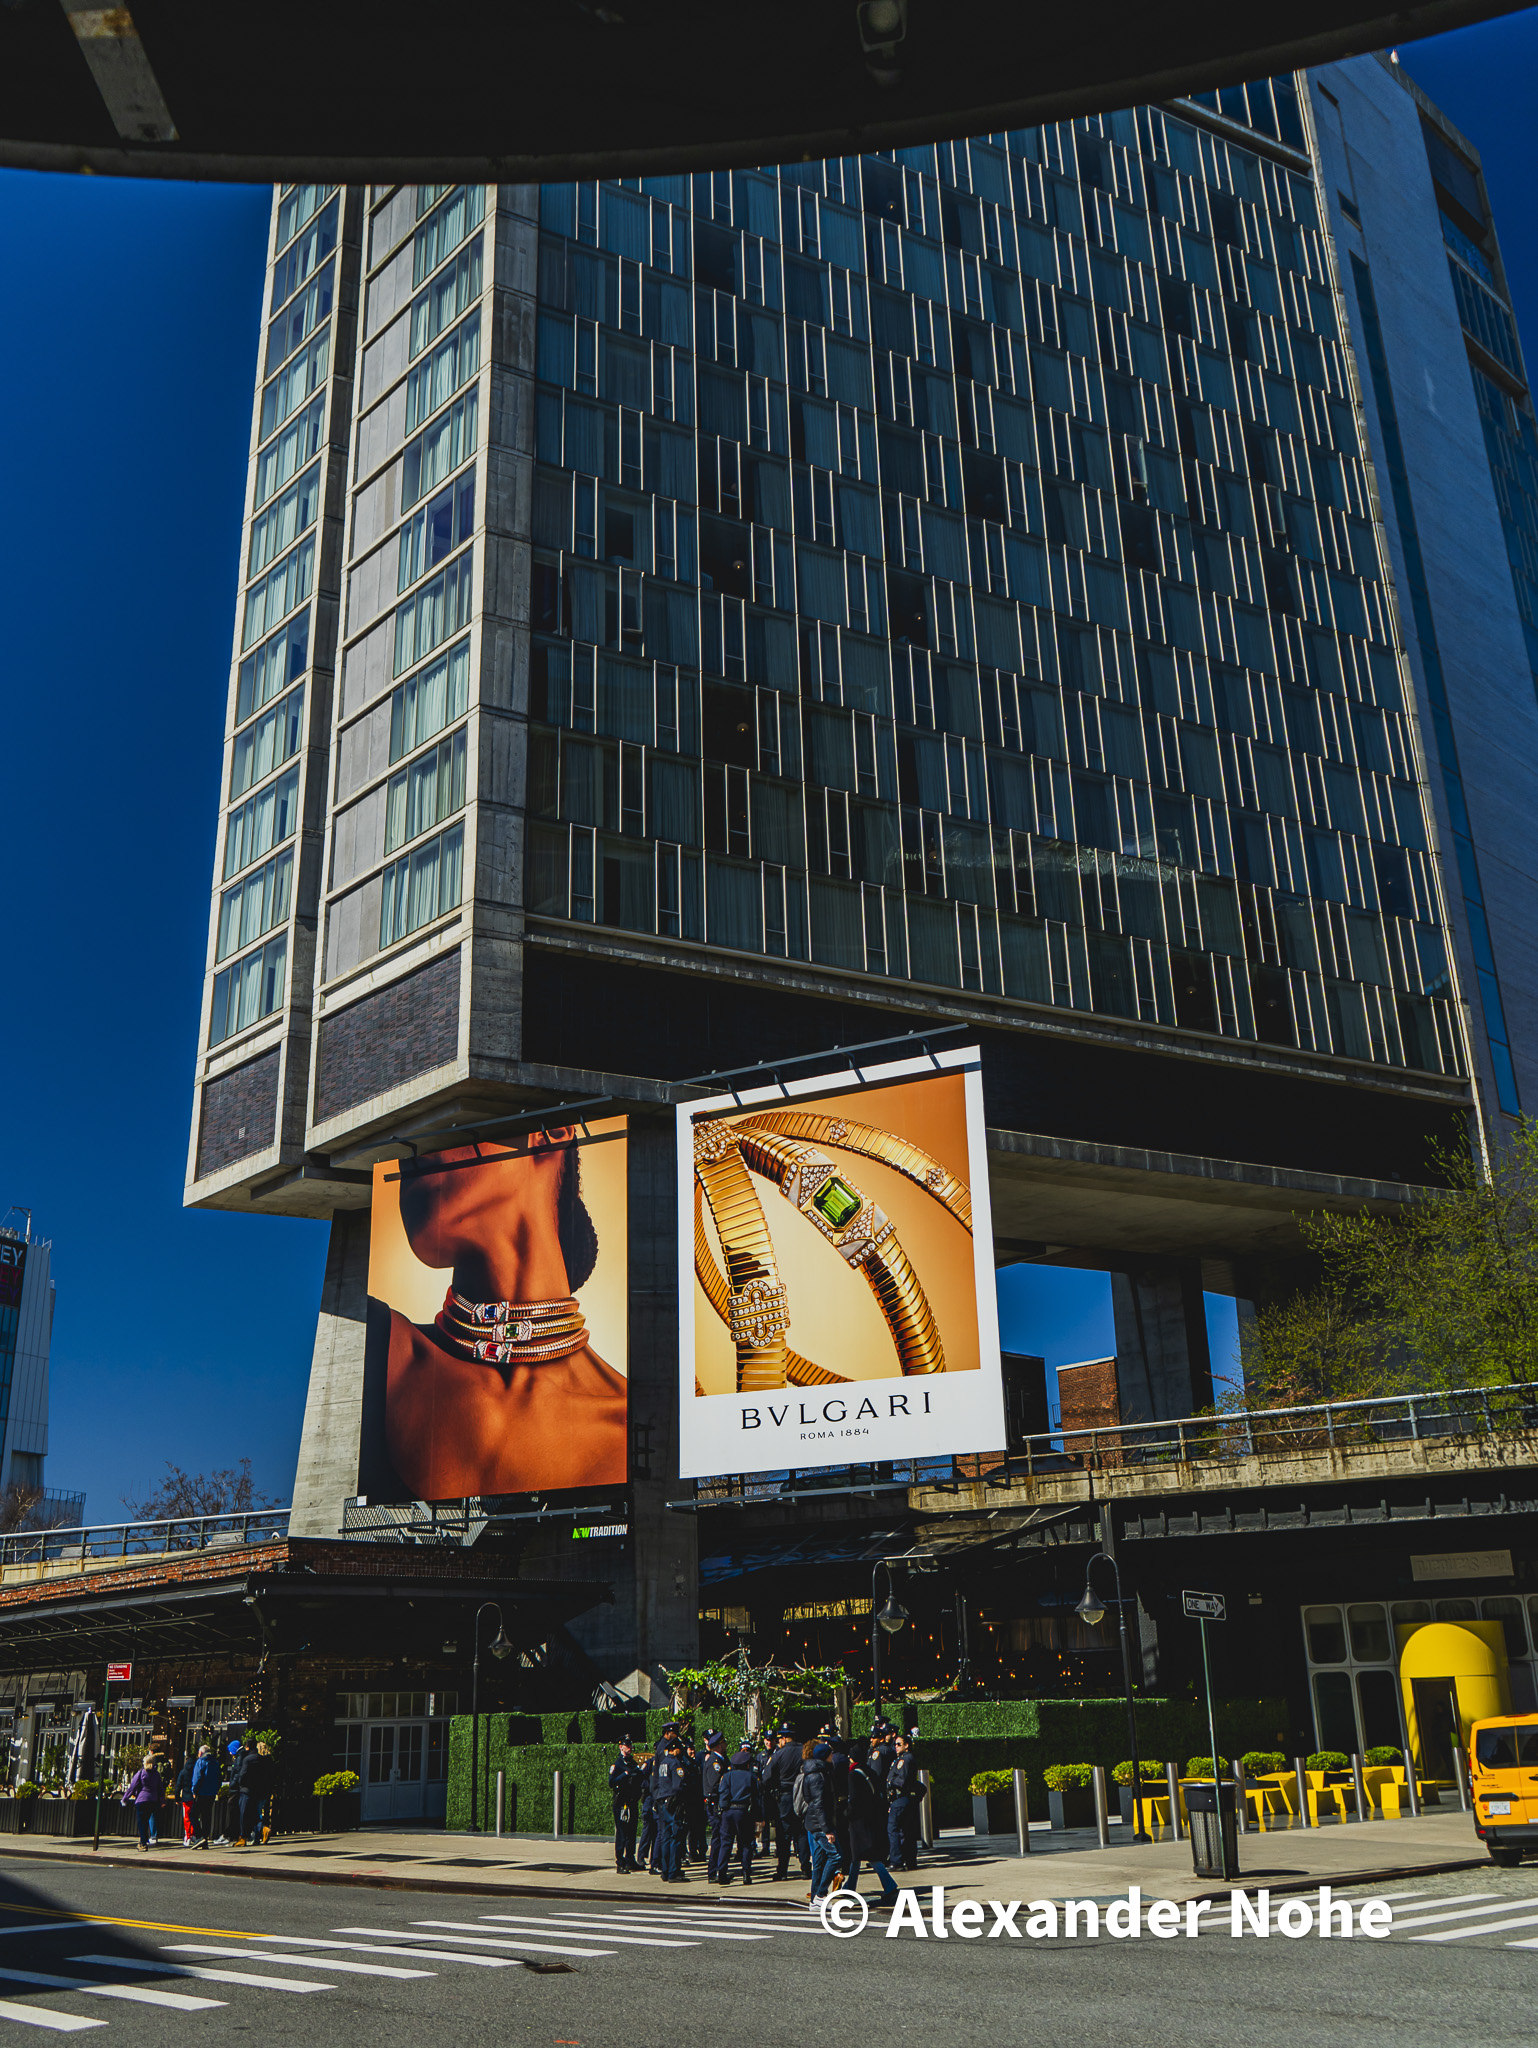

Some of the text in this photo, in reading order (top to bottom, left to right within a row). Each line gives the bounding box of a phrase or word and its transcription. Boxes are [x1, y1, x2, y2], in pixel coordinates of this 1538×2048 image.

[0, 1244, 23, 1266] EY
[741, 1391, 931, 1430] BVLGARI
[800, 1427, 869, 1440] ROMA 1884
[1187, 1599, 1219, 1611] ONE WAY
